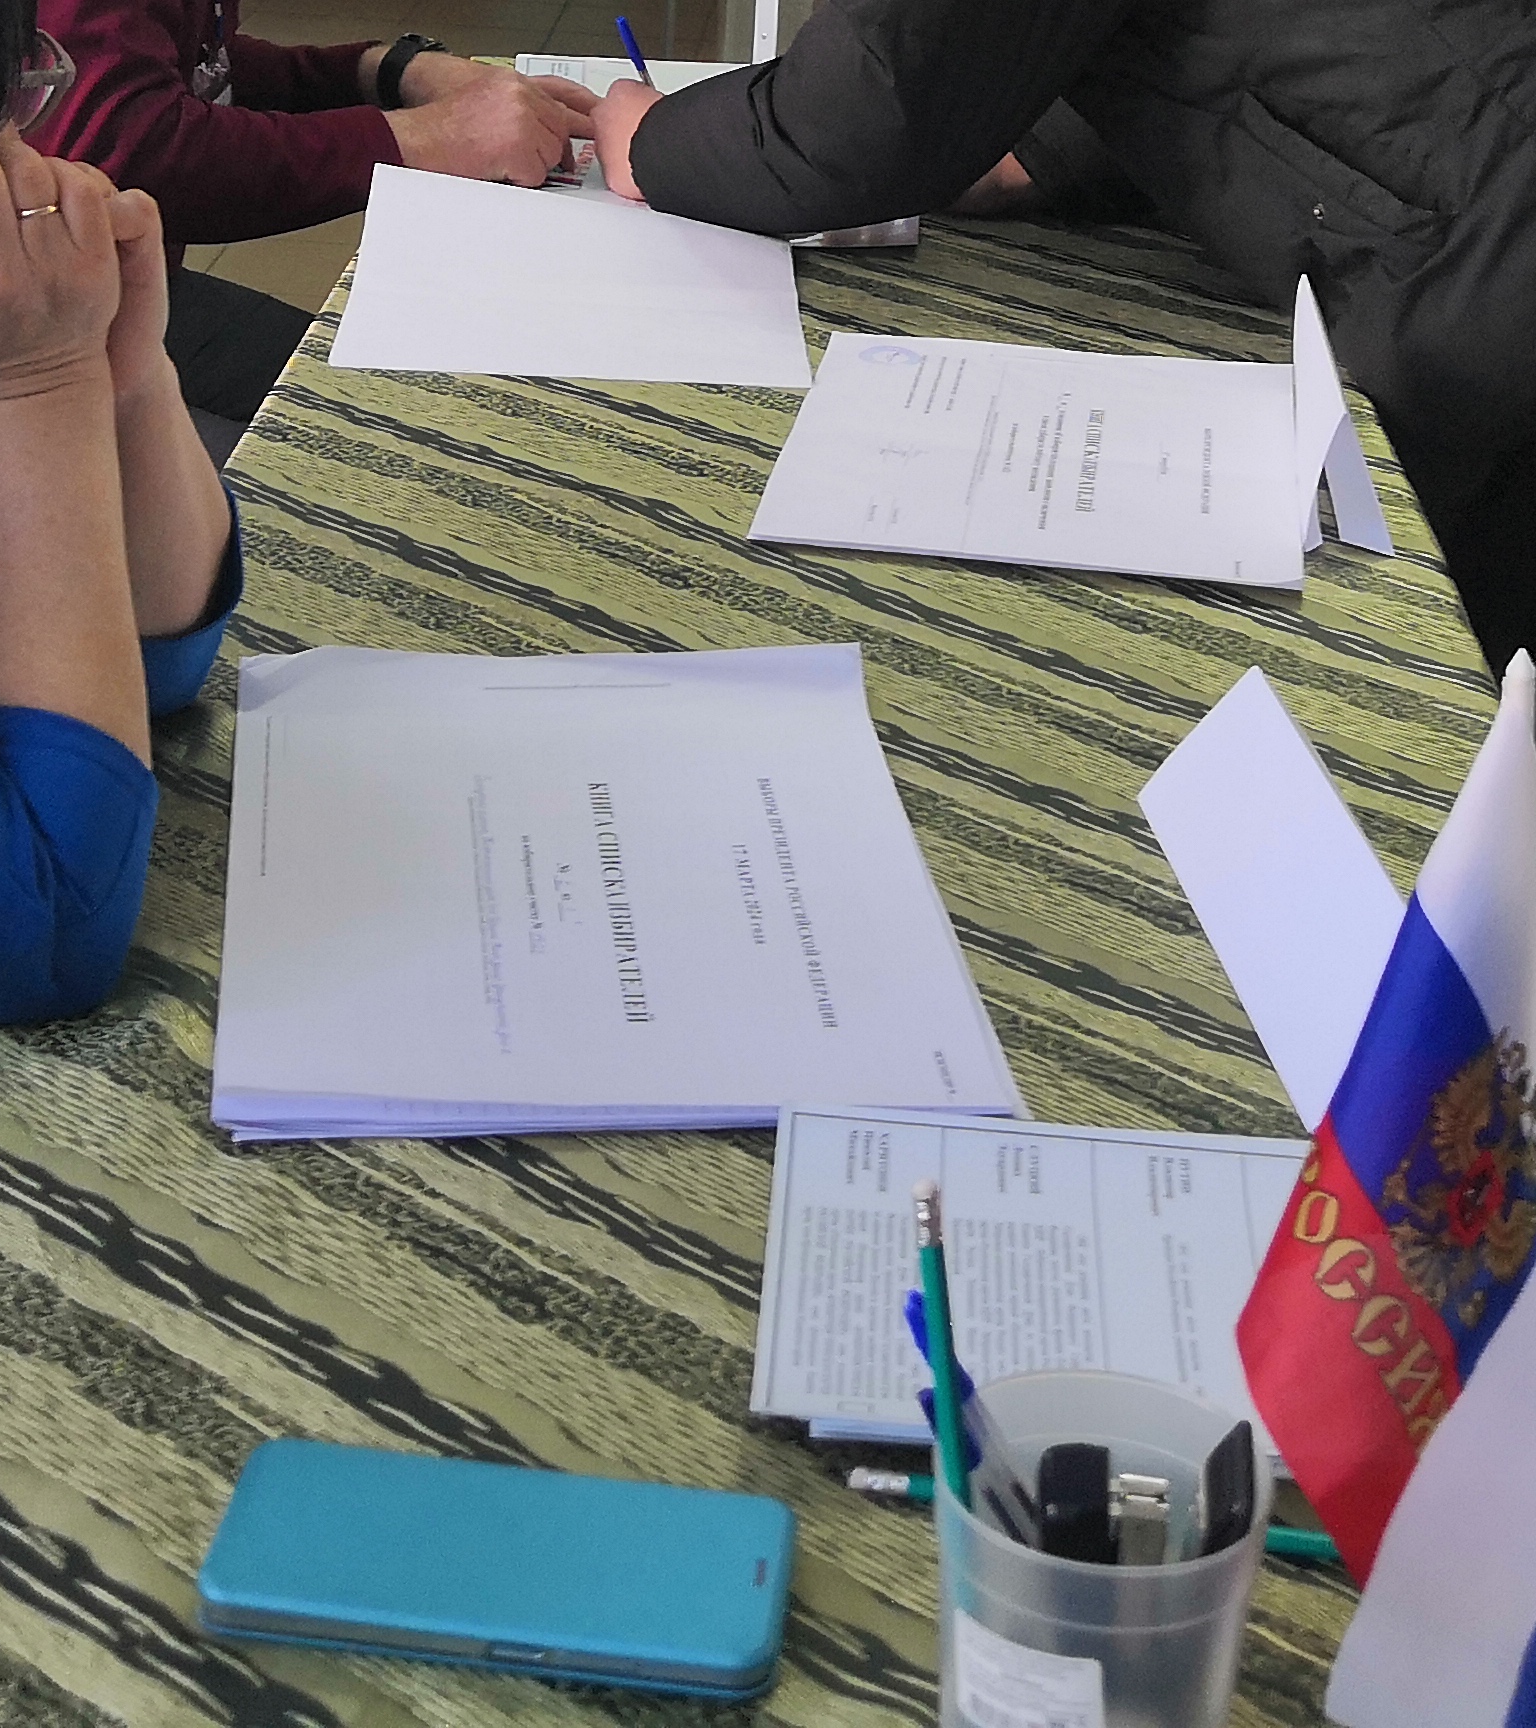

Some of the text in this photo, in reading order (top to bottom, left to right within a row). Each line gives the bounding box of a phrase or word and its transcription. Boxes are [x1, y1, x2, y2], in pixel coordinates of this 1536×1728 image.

[587, 782, 656, 1023] КНИГА СПИСКА ИЗБИРАТЕЛЕЙ
